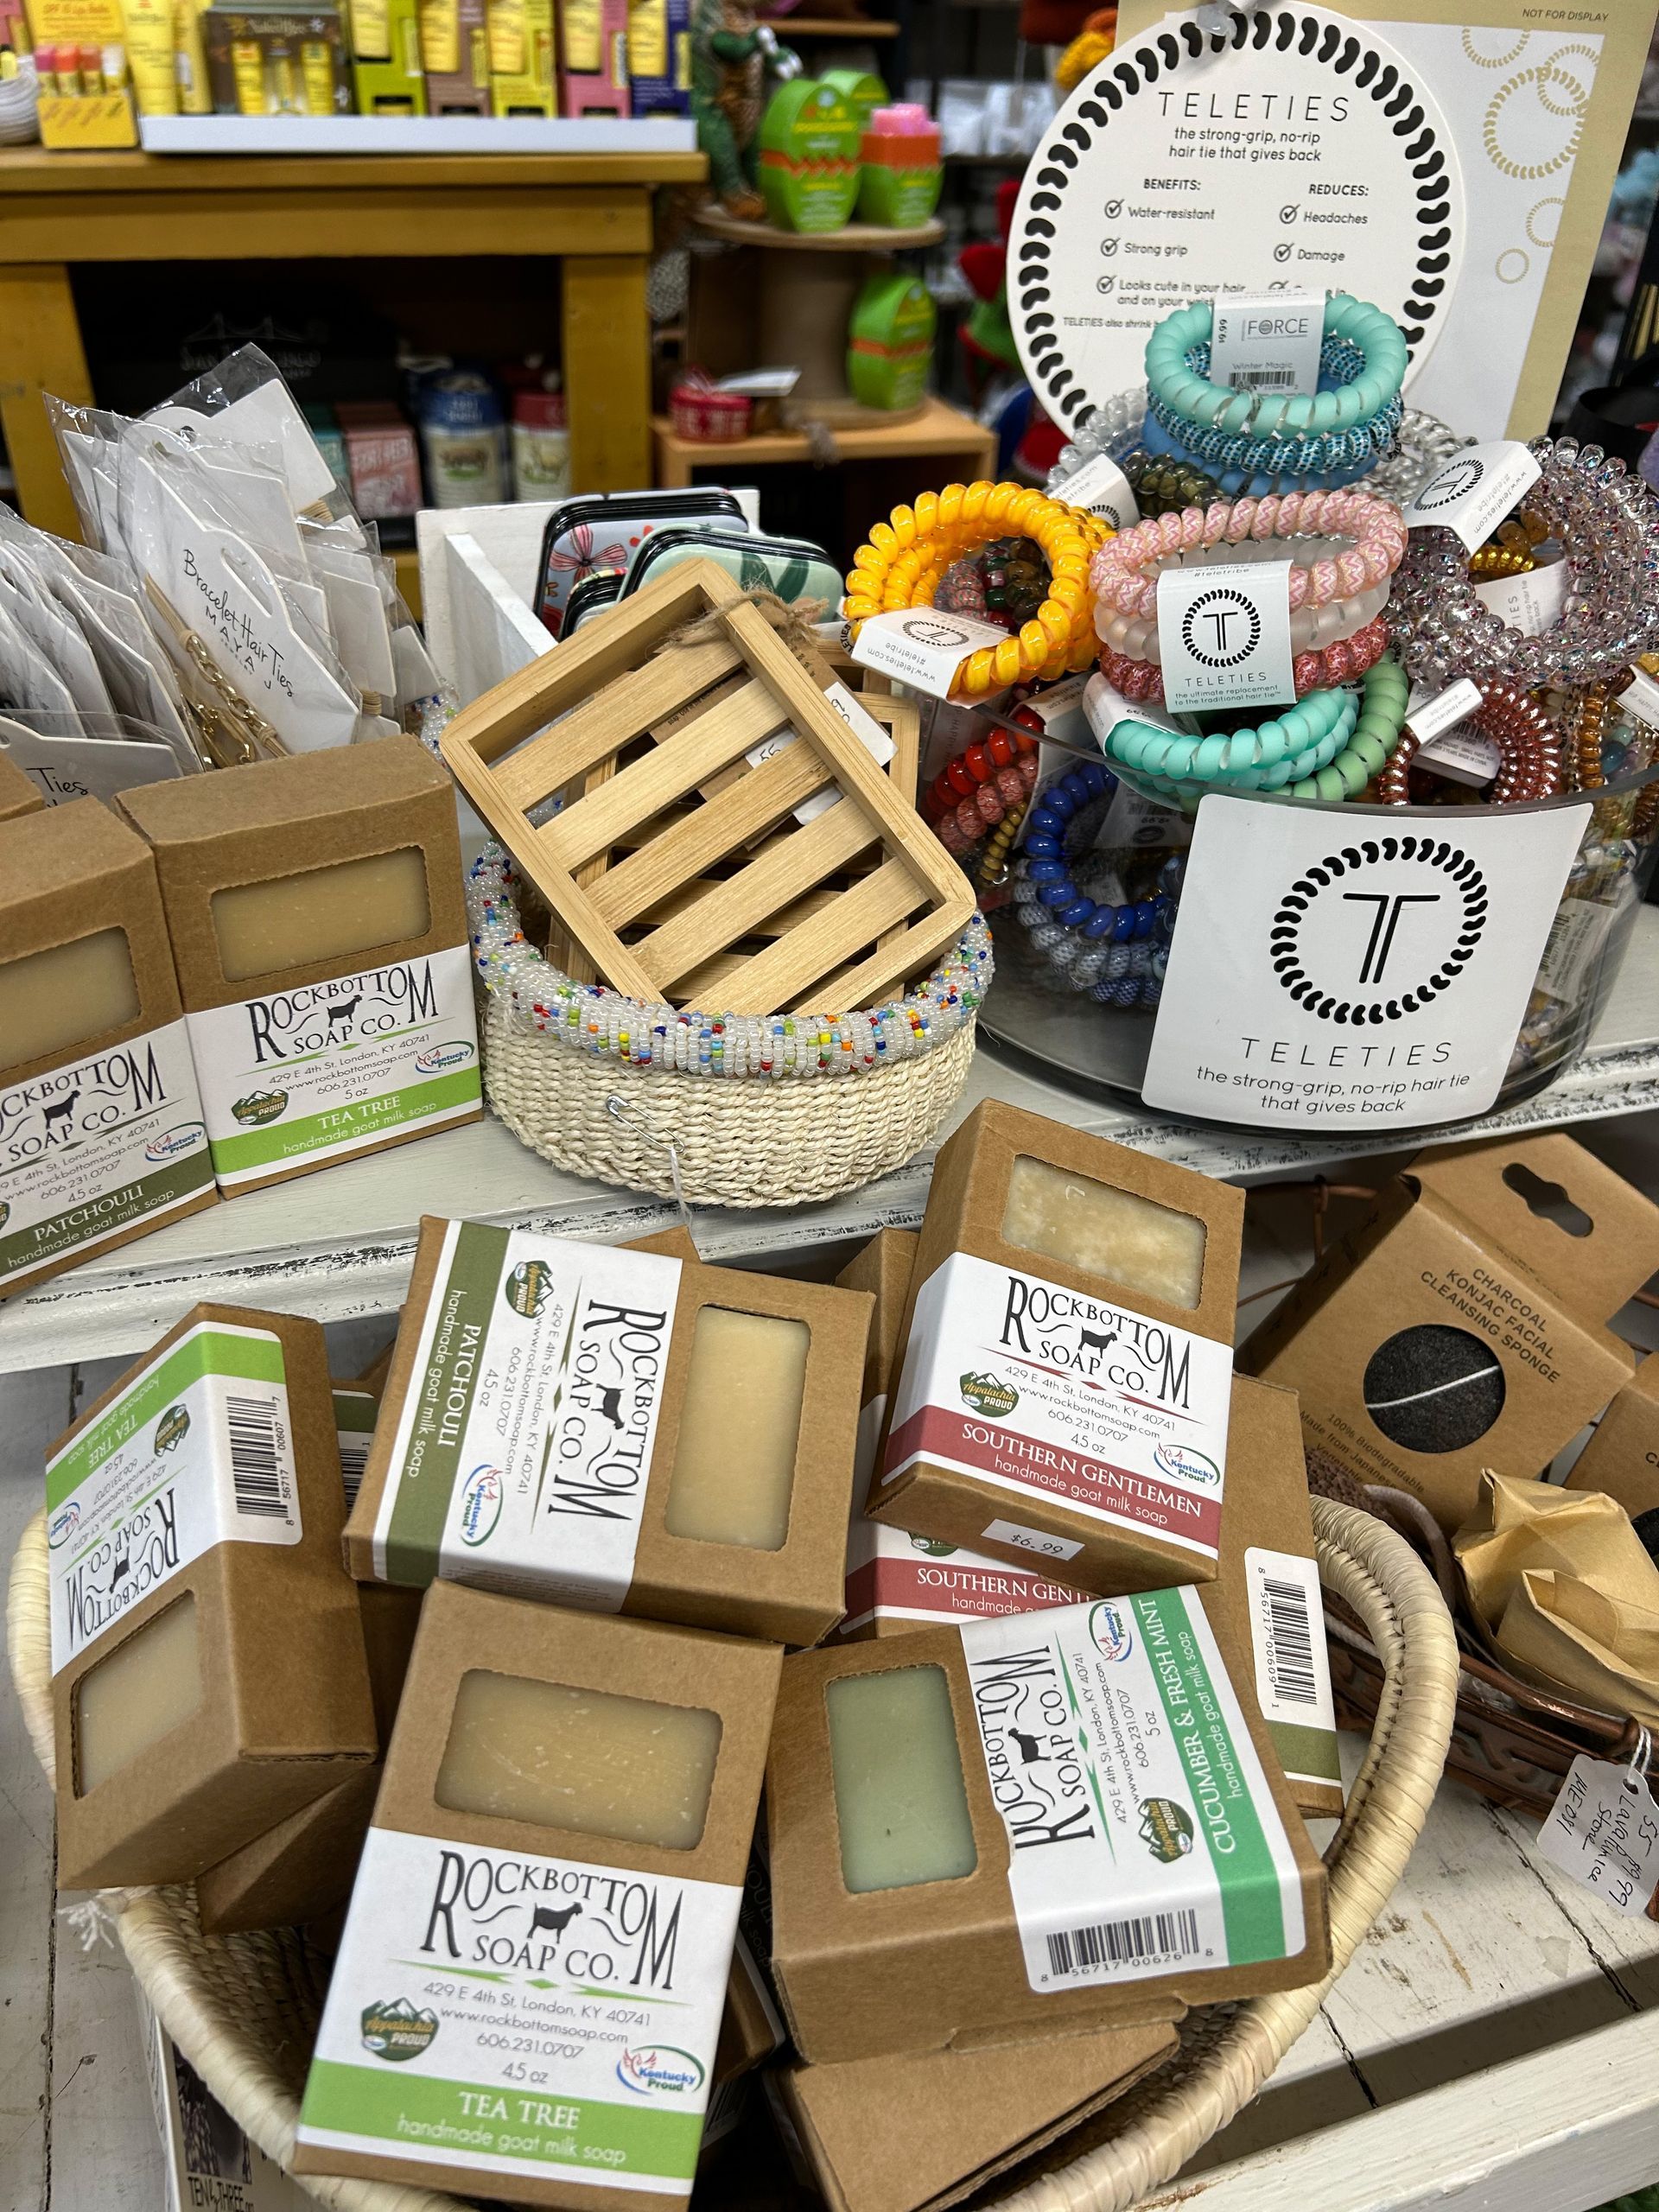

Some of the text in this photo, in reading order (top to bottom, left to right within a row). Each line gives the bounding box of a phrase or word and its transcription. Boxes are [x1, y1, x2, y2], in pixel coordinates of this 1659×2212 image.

[1522, 9, 1609, 22] NOT FOR DISPLAY
[1159, 92, 1348, 121] TELETIES
[1169, 145, 1320, 162] hair tie that gives back
[1175, 127, 1319, 145] the strong-grip, no-rip
[1144, 179, 1200, 189] BENEFITS:
[1309, 184, 1368, 195] REDUCES:
[1128, 207, 1214, 219] Water-resistant
[1304, 212, 1367, 224] Headaches
[1124, 242, 1187, 257] Strong grip
[1298, 249, 1344, 263] Damage
[1117, 295, 1139, 304] and
[1141, 294, 1154, 306] on
[1158, 298, 1184, 310] your
[1120, 280, 1151, 290] Looks
[1154, 282, 1179, 291] cute
[1194, 284, 1219, 294] your
[1223, 283, 1245, 292] hair
[183, 549, 293, 697] Bracelet Hair Ties
[867, 647, 937, 683] www.teleties.com
[885, 641, 927, 666] #teletribe
[1185, 671, 1267, 688] TELETIES
[1190, 689, 1224, 698] ultimate
[1226, 685, 1279, 695] replacement
[1201, 695, 1244, 704] traditional
[27, 766, 90, 797] Ties
[245, 959, 438, 1063] ROCKBOTTOM
[294, 1014, 400, 1053] SOAP CO.
[1241, 1037, 1452, 1067] TELETIES
[1196, 1065, 1470, 1097] the strong-grip, no-rip hair tie
[317, 1096, 400, 1128] TEA TREE
[1261, 1095, 1407, 1116] that gives back
[9, 1105, 125, 1161] SOAP CO.
[283, 1103, 435, 1154] handmade goat milk soap
[35, 1185, 143, 1241] PATCHOULI
[1446, 1269, 1504, 1317] KONJAC
[1505, 1315, 1553, 1359] FACIAL
[1473, 1268, 1545, 1332] CHARCOAL
[999, 1276, 1190, 1408] ROCKBOTTOM
[1421, 1271, 1500, 1335] CLEANSING
[1501, 1334, 1560, 1382] SPONGE
[406, 1290, 467, 1477] handmade goat milk soap
[437, 1324, 481, 1446] PATCHOULI
[1039, 1340, 1147, 1393] SOAP CO.
[548, 1300, 666, 1520] ROCKBOTTOM
[559, 1340, 600, 1463] SOAP CO.
[982, 1392, 1014, 1413] PROUD
[1005, 1366, 1027, 1378] 429
[1031, 1373, 1037, 1382] E
[1042, 1379, 1058, 1390] 4th
[1123, 1406, 1138, 1416] KY
[1142, 1414, 1174, 1430] 40741
[1019, 1386, 1160, 1438] www.rockbottomsoap.com
[88, 1414, 137, 1470] TEA TREE
[1048, 1409, 1128, 1441] 606.231.0707
[1296, 1411, 1325, 1433] Made
[1327, 1433, 1353, 1453] from
[1328, 1414, 1357, 1438] 100%
[1091, 1444, 1105, 1454] oz
[963, 1423, 1201, 1516] SOUTHERN GENTLEMEN
[1169, 1459, 1213, 1479] Kentucky
[1178, 1467, 1205, 1483] Proud
[995, 1453, 1167, 1525] handmade goat milk soap
[115, 1507, 150, 1552] SOAP
[66, 1488, 180, 1647] ROCKBOTTOM
[917, 1567, 1027, 1597] SOUTHERN
[952, 1593, 1021, 1614] handmade
[1138, 1599, 1235, 1853] CUCUMBER & FRESH MINT
[1178, 1631, 1243, 1798] handmade goat milk soap
[970, 1645, 1095, 1852] ROCKBOTTOM
[1039, 1684, 1085, 1797] SOAP CO.
[420, 1850, 683, 1989] ROCKBOTTOM
[473, 1935, 618, 1980] SOAP CO.
[459, 2091, 582, 2131] TEA TREE
[397, 2113, 628, 2167] handmade goat milk soap
